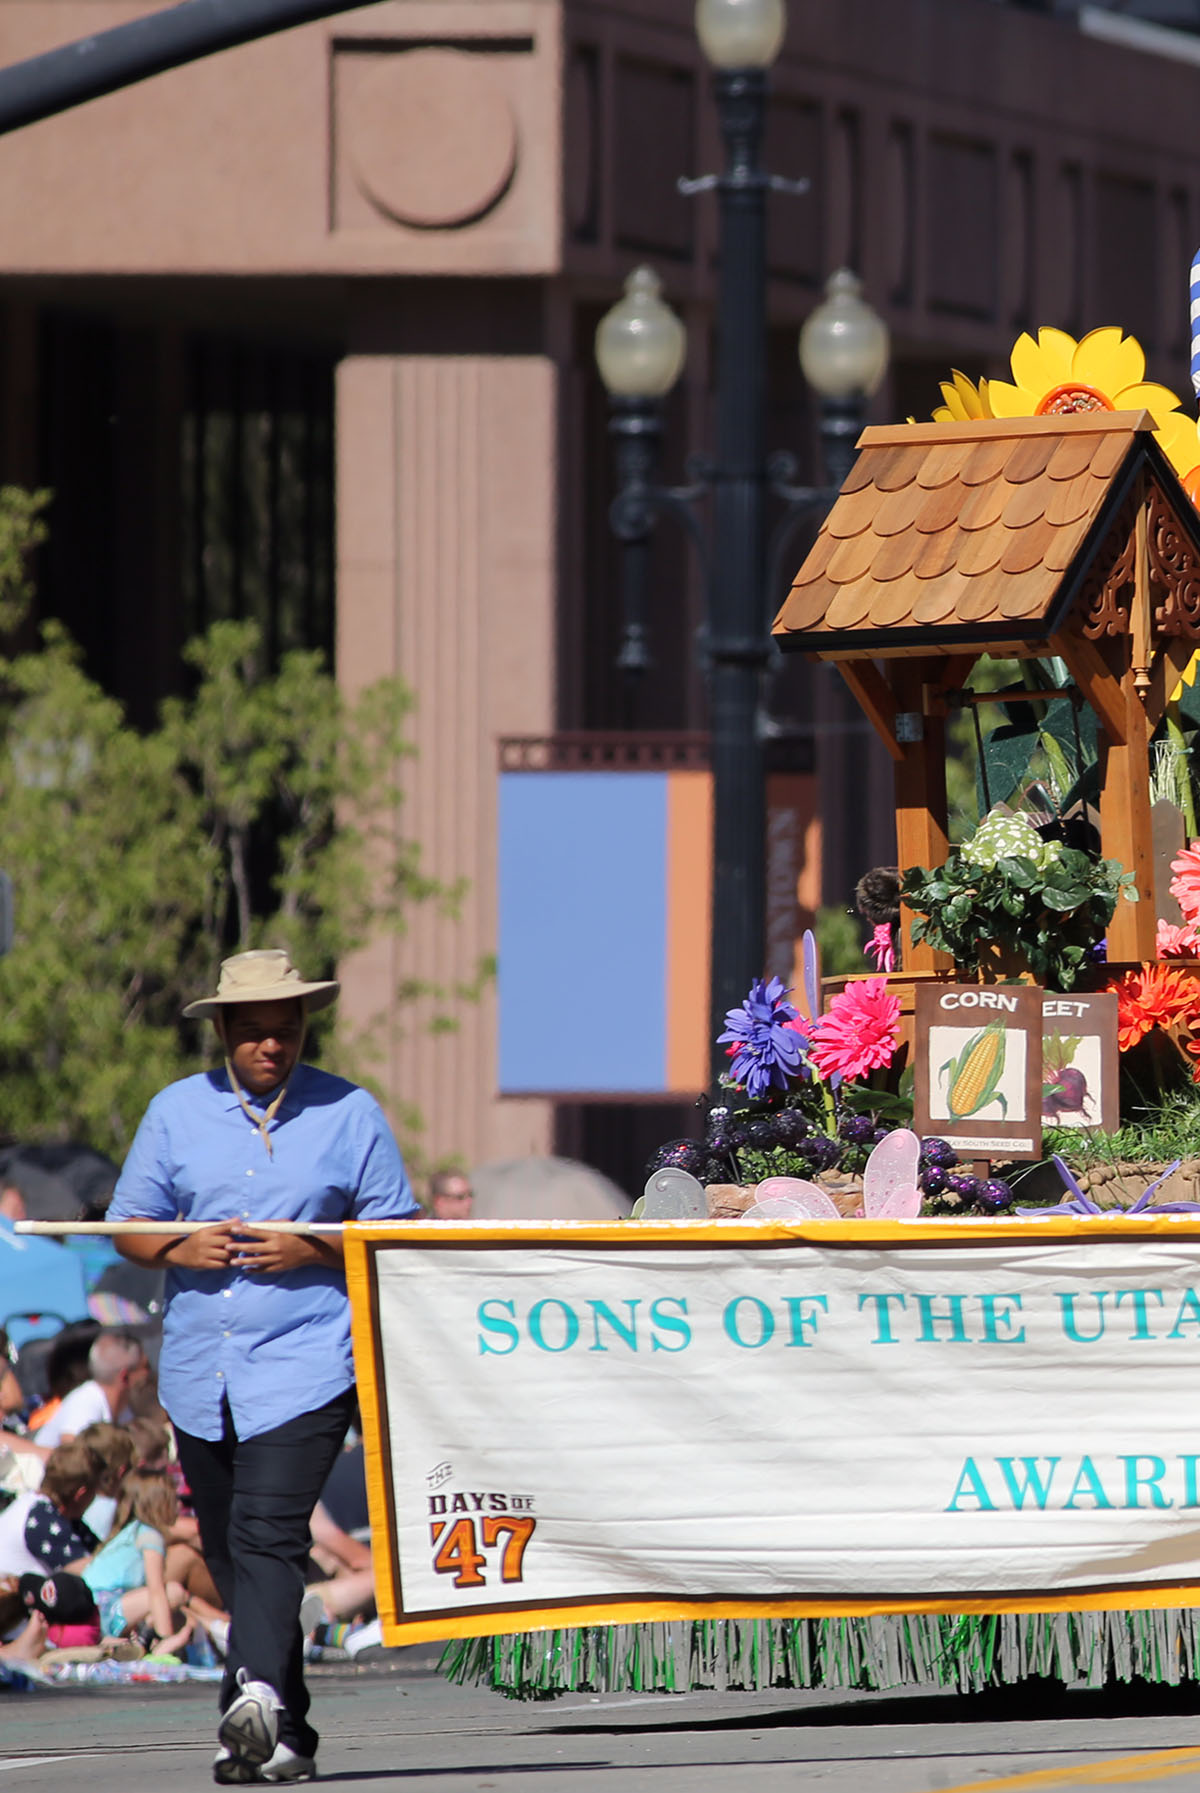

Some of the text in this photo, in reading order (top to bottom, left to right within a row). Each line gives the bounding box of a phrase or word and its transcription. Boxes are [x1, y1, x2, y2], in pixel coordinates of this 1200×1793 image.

[940, 991, 1018, 1012] CORN
[1042, 1000, 1090, 1017] EET
[477, 1297, 692, 1355] SONS
[723, 1294, 829, 1349] OF
[858, 1292, 1026, 1344] THE
[425, 1464, 453, 1488] THE
[427, 1492, 535, 1516] DAYS OF
[429, 1514, 537, 1590] '47
